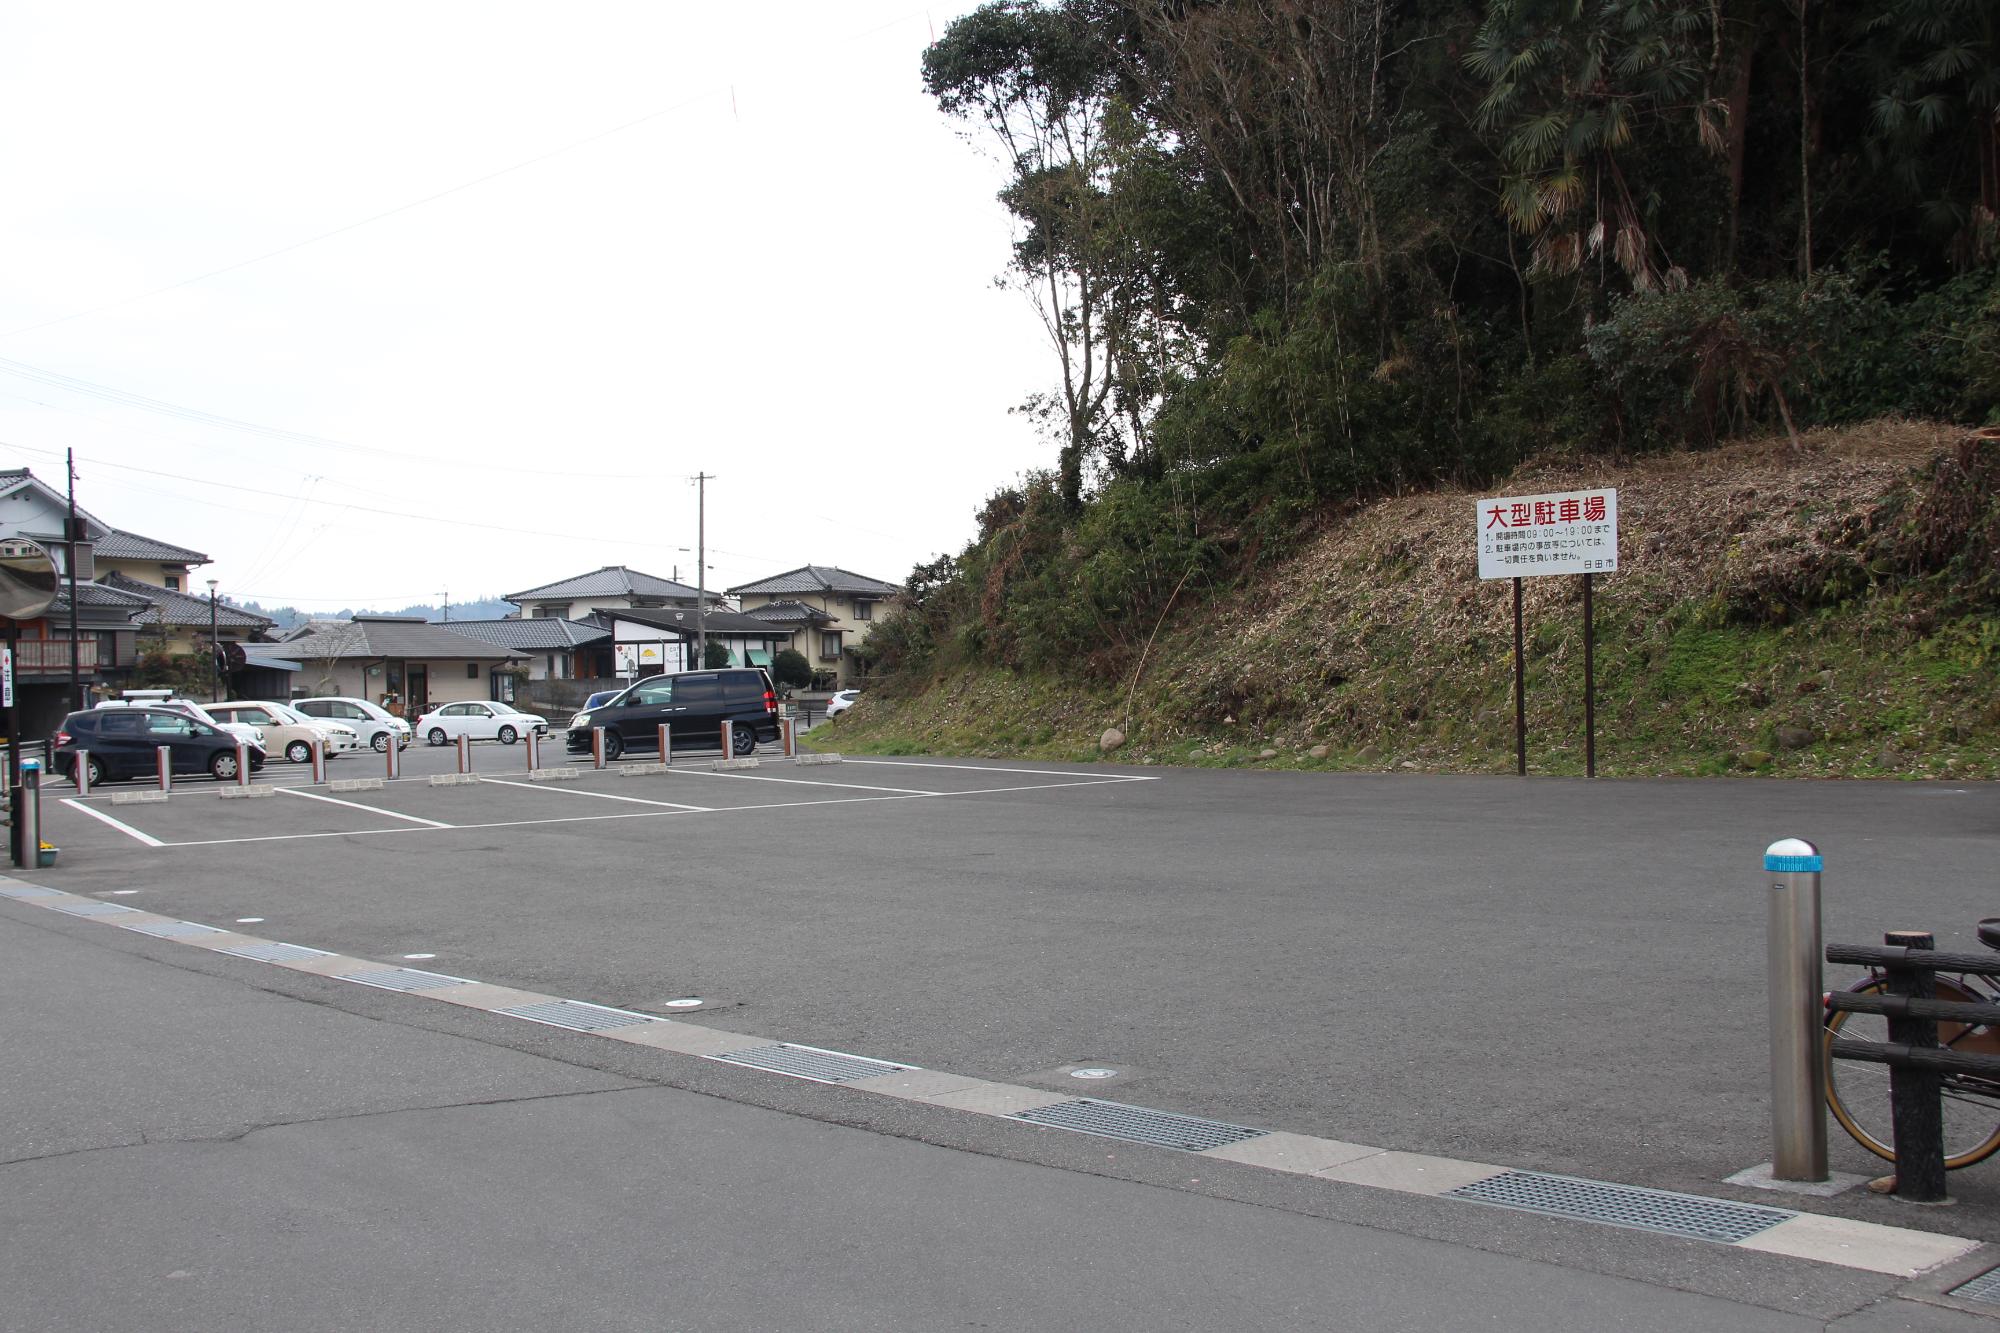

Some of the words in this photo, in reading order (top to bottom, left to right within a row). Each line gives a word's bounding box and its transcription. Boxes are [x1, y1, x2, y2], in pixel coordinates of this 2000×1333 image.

[1486, 495, 1606, 529] 大型駐車場
[1584, 559, 1614, 569] 日田市
